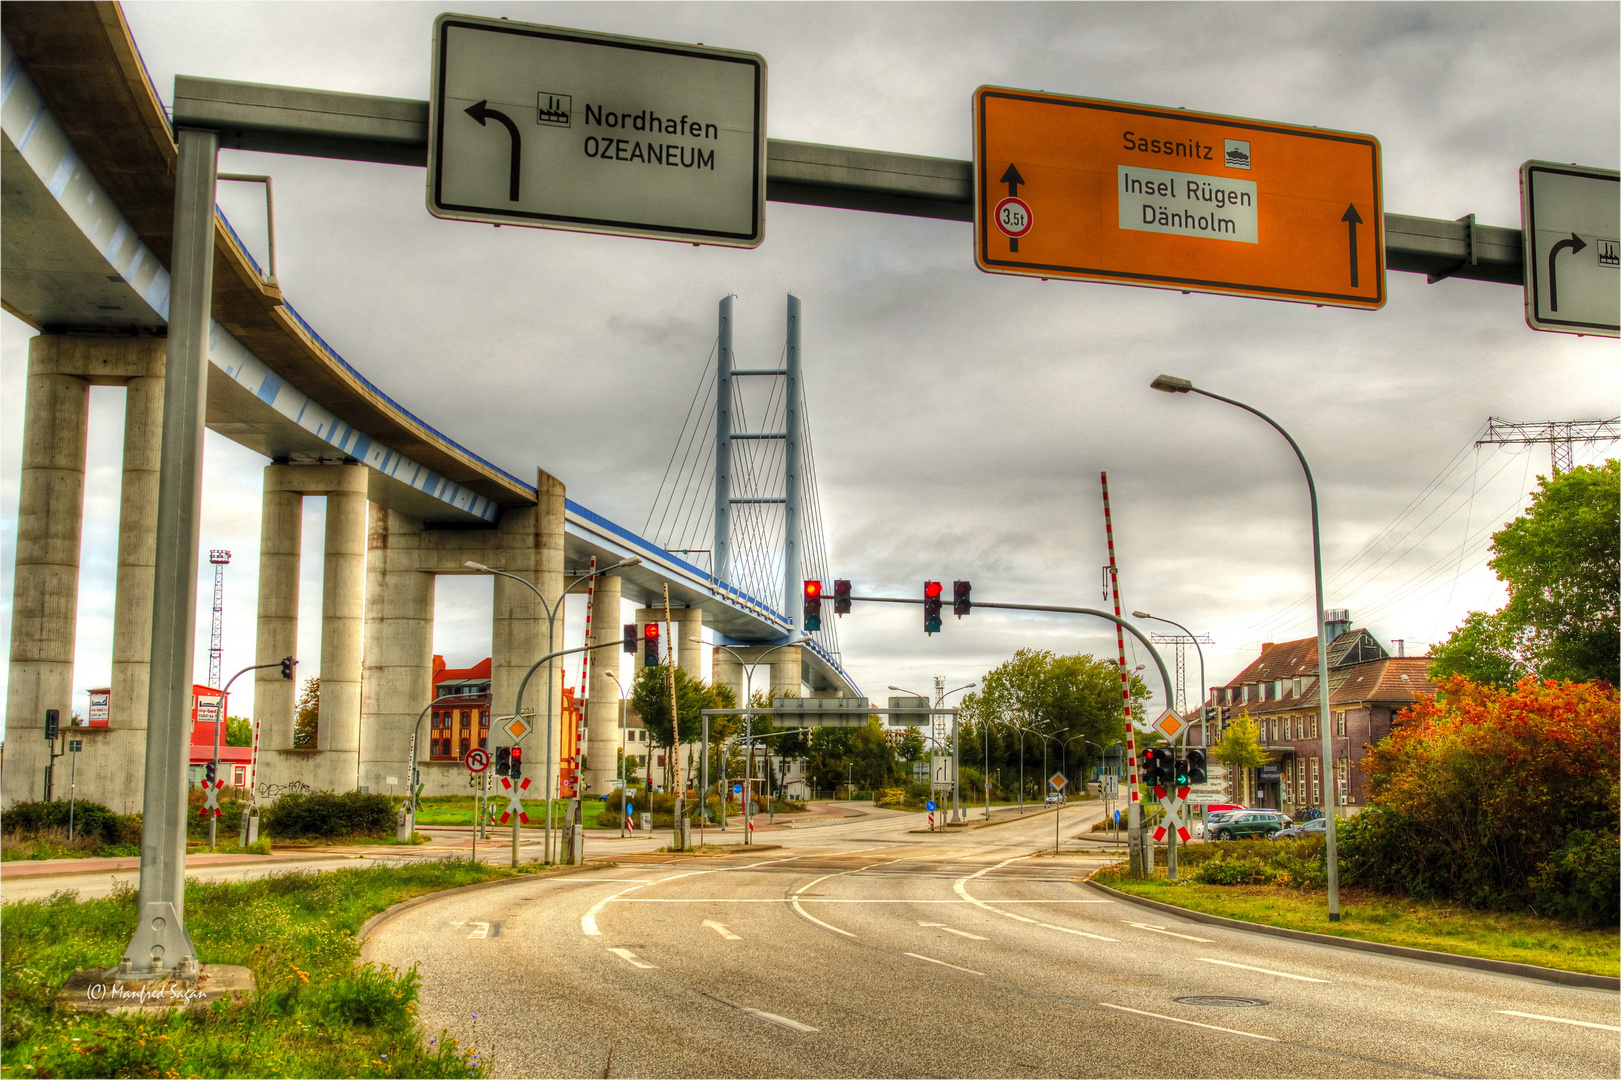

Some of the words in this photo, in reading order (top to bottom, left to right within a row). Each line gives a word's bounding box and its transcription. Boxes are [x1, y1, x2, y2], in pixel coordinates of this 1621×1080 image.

[585, 103, 718, 140] Nordhafen
[584, 136, 715, 171] OZEANEUM
[1123, 131, 1213, 160] Sassnitz
[1125, 173, 1176, 198] Insel
[1186, 180, 1251, 208] Rügen
[1143, 204, 1236, 234] Dänholm
